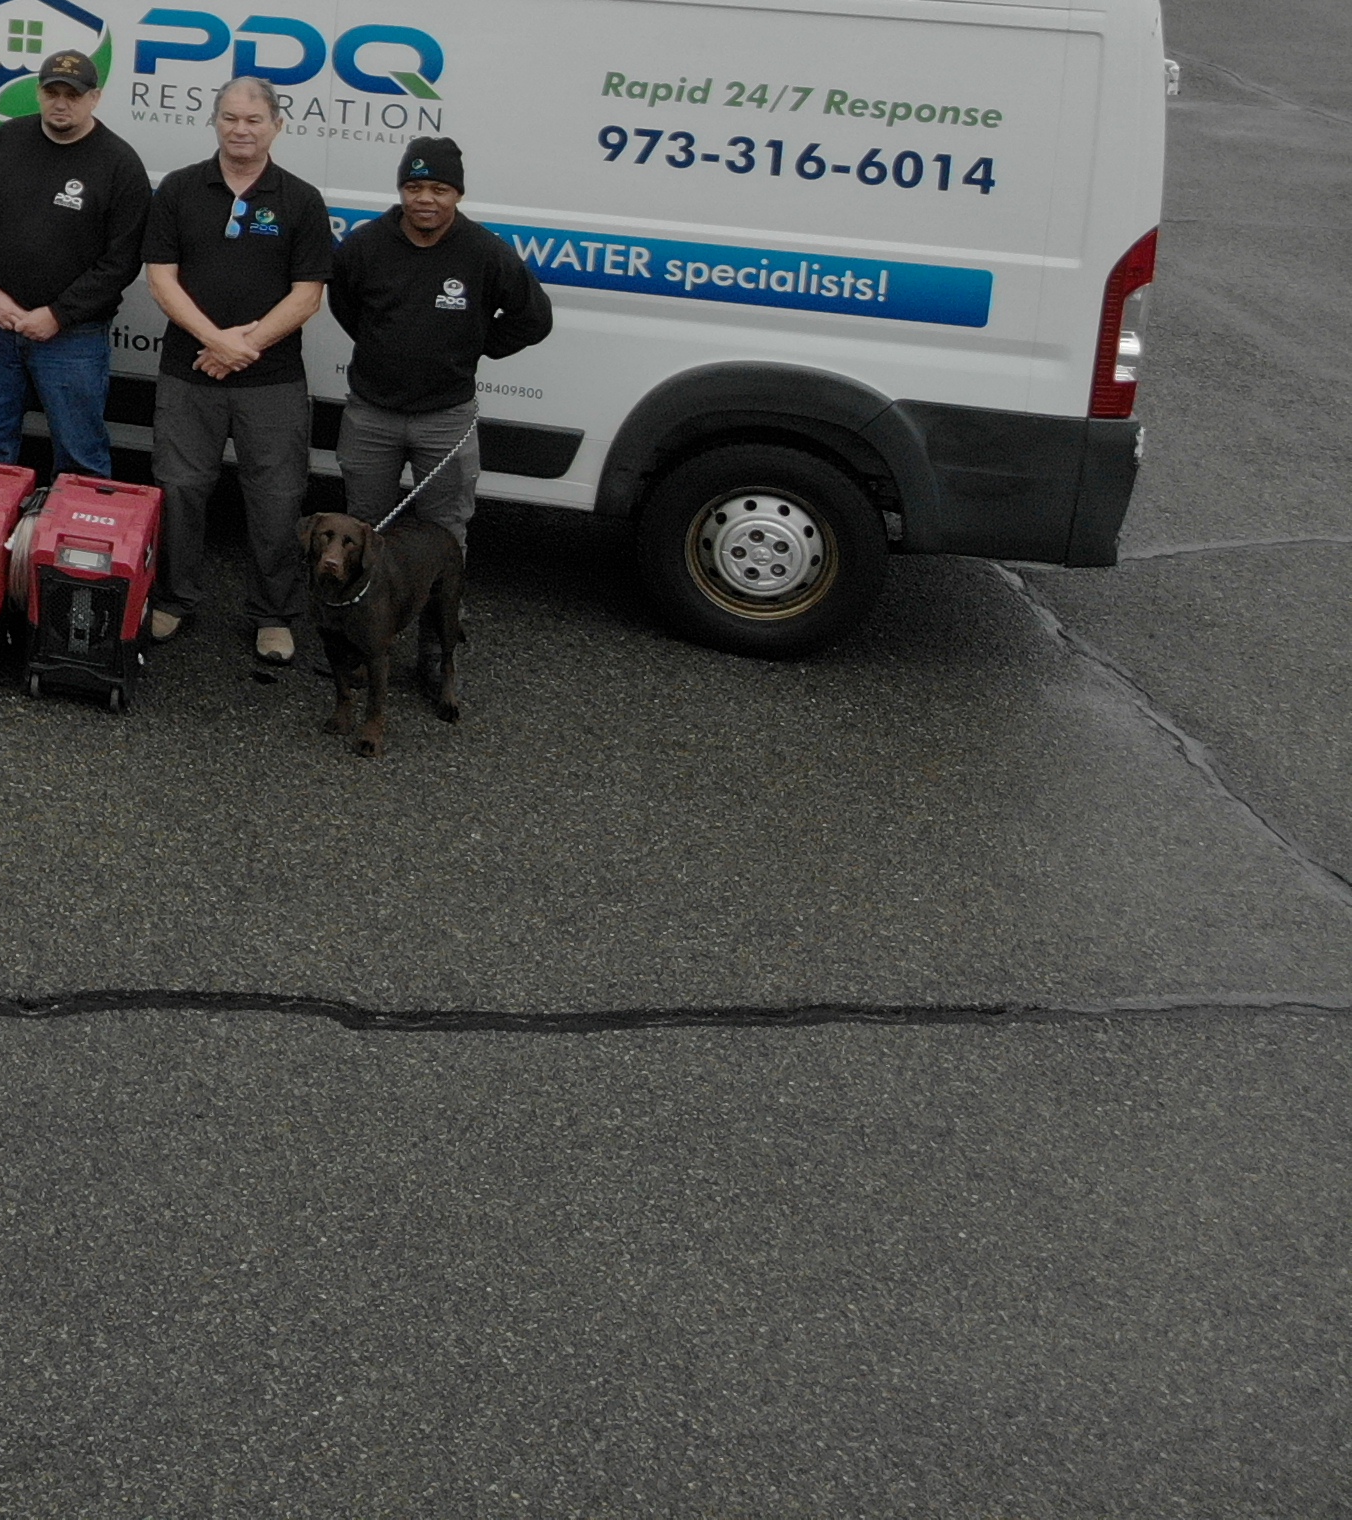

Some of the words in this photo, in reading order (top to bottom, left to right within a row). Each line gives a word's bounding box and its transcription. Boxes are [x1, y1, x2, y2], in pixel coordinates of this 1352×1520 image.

[134, 7, 445, 101] PDQ
[131, 81, 443, 133] RESRATION
[601, 70, 713, 109] Rapid
[722, 80, 815, 114] 24/7
[822, 89, 1004, 129] Response
[131, 109, 195, 127] WATER
[597, 125, 997, 196] 973-316-6014
[54, 192, 83, 206] PDQ
[249, 223, 279, 235] PDQ
[511, 233, 653, 281] WATER
[664, 256, 889, 303] specialists!
[435, 294, 467, 308] PDQ
[71, 511, 116, 526] PDQ
